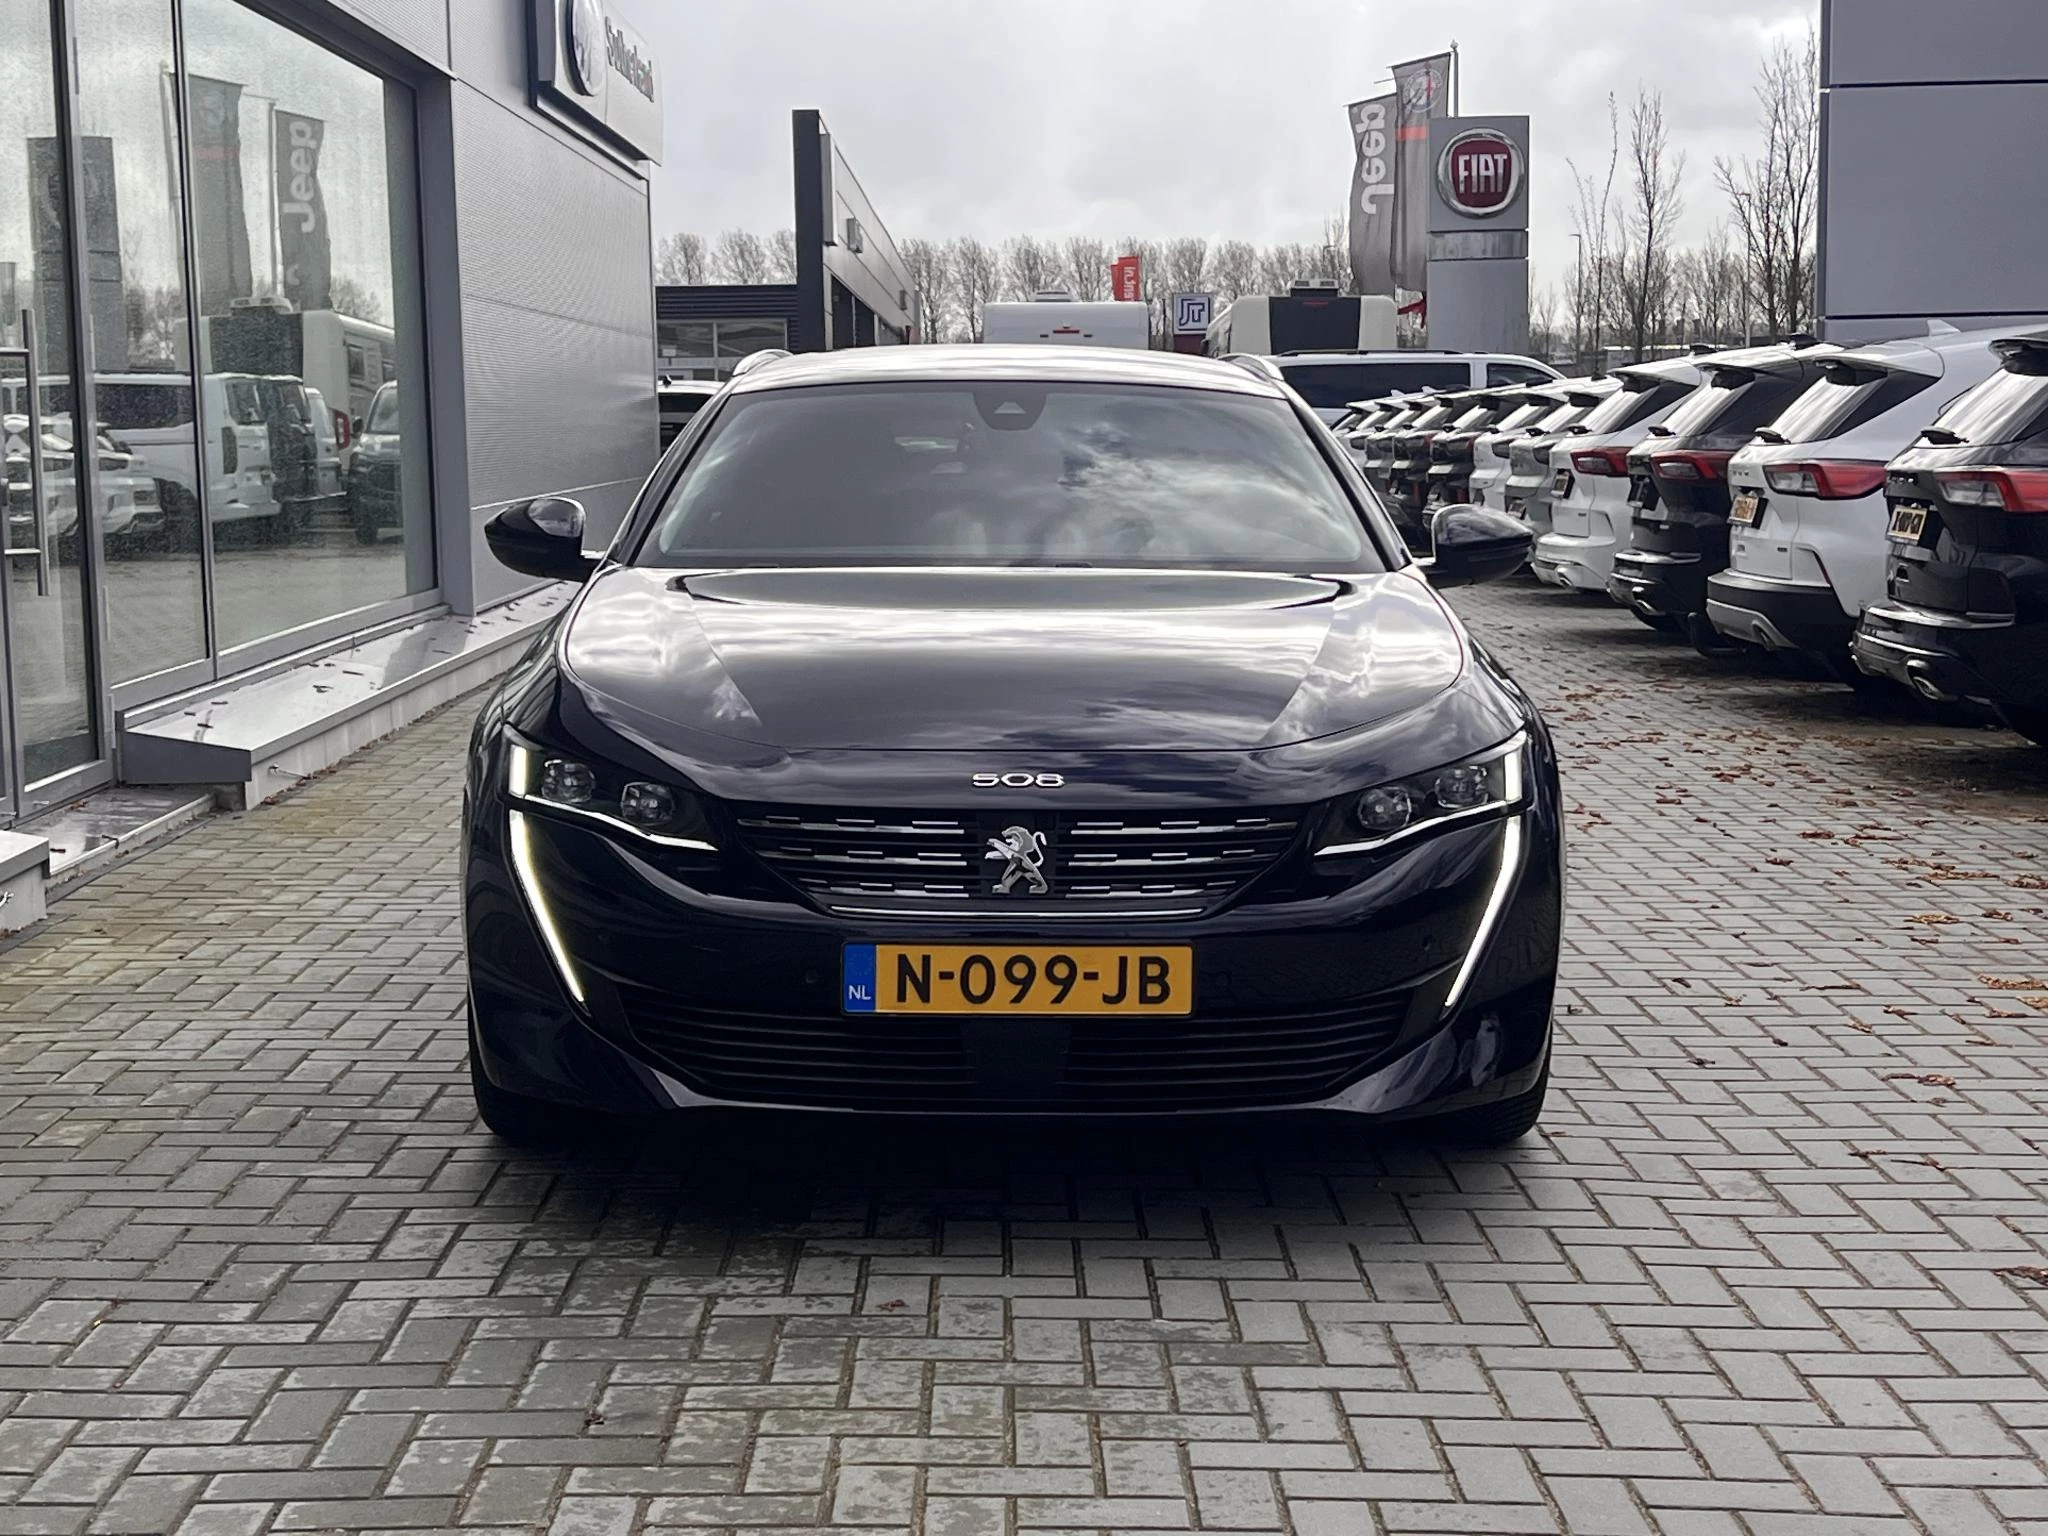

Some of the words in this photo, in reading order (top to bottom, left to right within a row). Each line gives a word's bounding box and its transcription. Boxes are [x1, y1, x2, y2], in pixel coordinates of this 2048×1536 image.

[282, 121, 317, 233] Jeep
[1458, 154, 1507, 193] FIAT
[972, 773, 1065, 787] 508
[848, 985, 871, 1000] NL
[896, 954, 1171, 1005] N-099-JB
